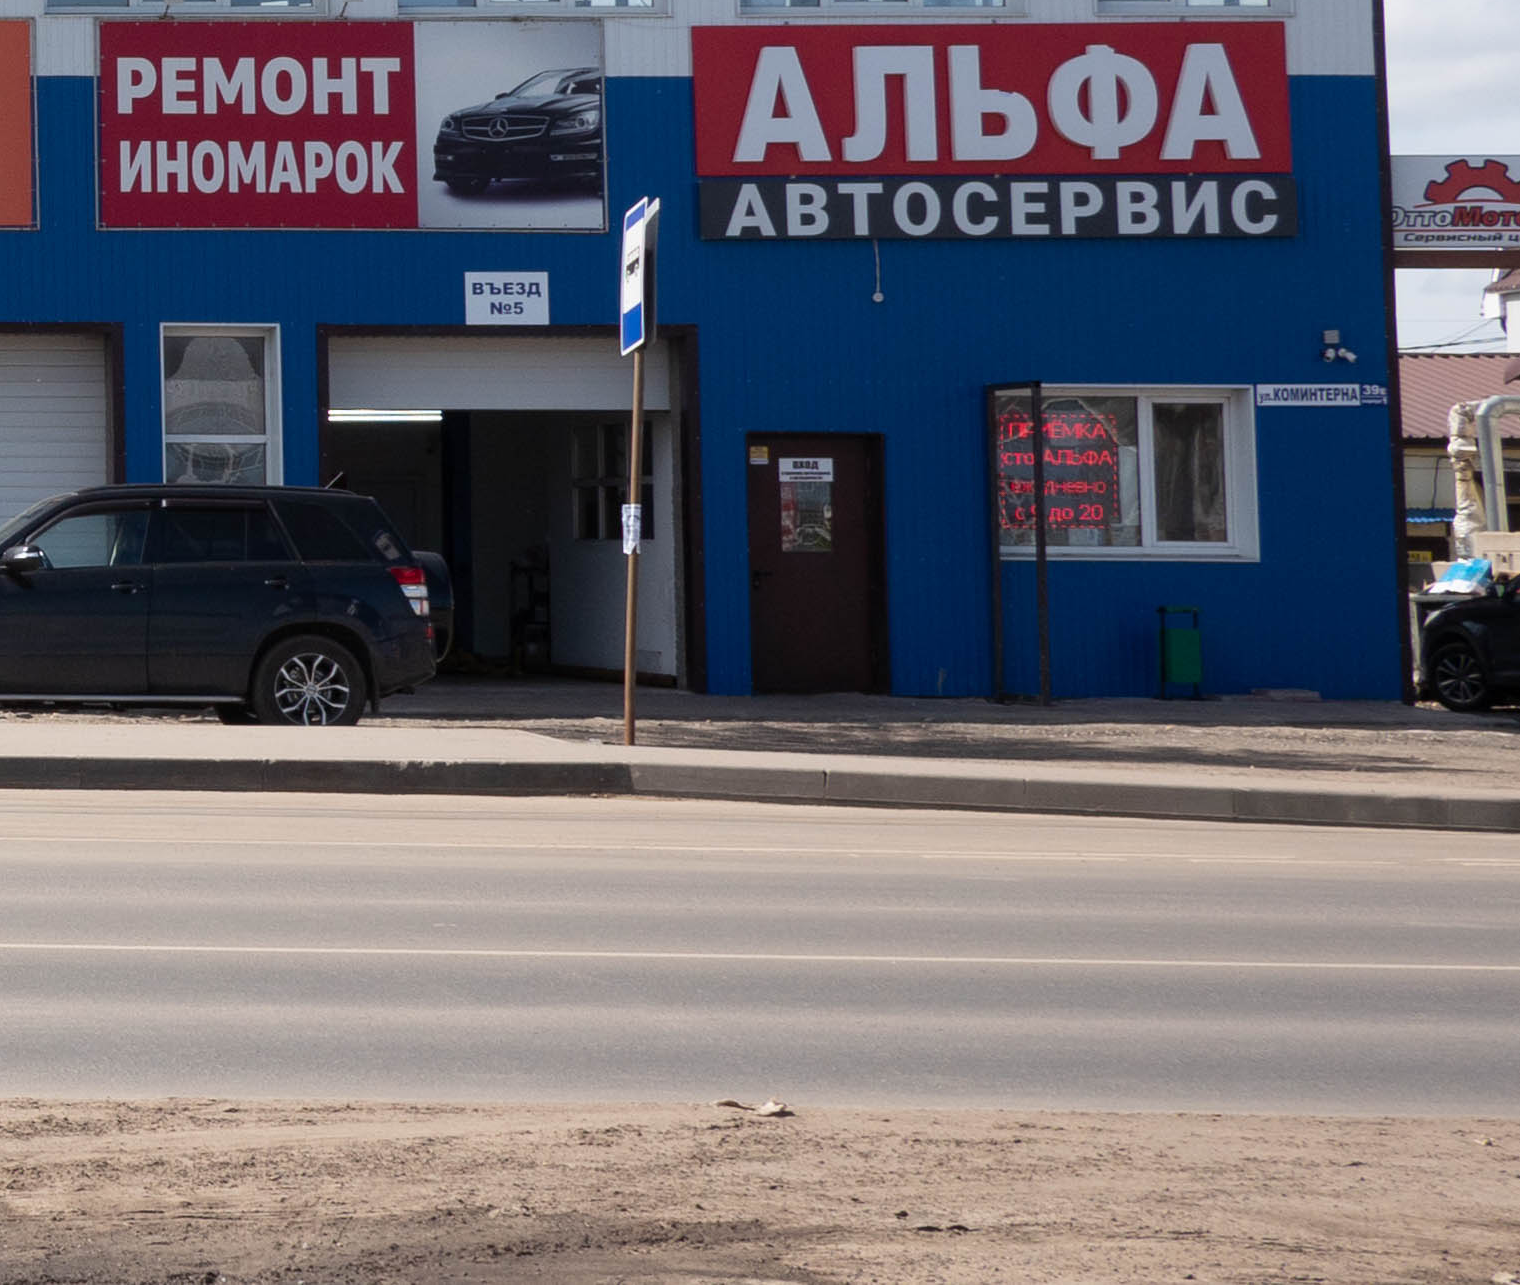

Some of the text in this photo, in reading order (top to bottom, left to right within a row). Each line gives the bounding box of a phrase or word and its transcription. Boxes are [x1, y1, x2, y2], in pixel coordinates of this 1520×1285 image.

[116, 55, 401, 116] РЕМОНТ
[733, 43, 1262, 164] АЛЬФА
[119, 138, 406, 196] ИНОМАРОК
[725, 180, 1280, 238] АВТОСЕРВИС
[1403, 232, 1503, 243] Сервисный
[471, 281, 543, 300] ВЪЕЗД
[489, 301, 525, 317] №5
[1043, 449, 1113, 466] АЛЬФА
[1010, 480, 1106, 496] еждневно
[1048, 507, 1075, 522] до
[1078, 504, 1104, 521] 20
